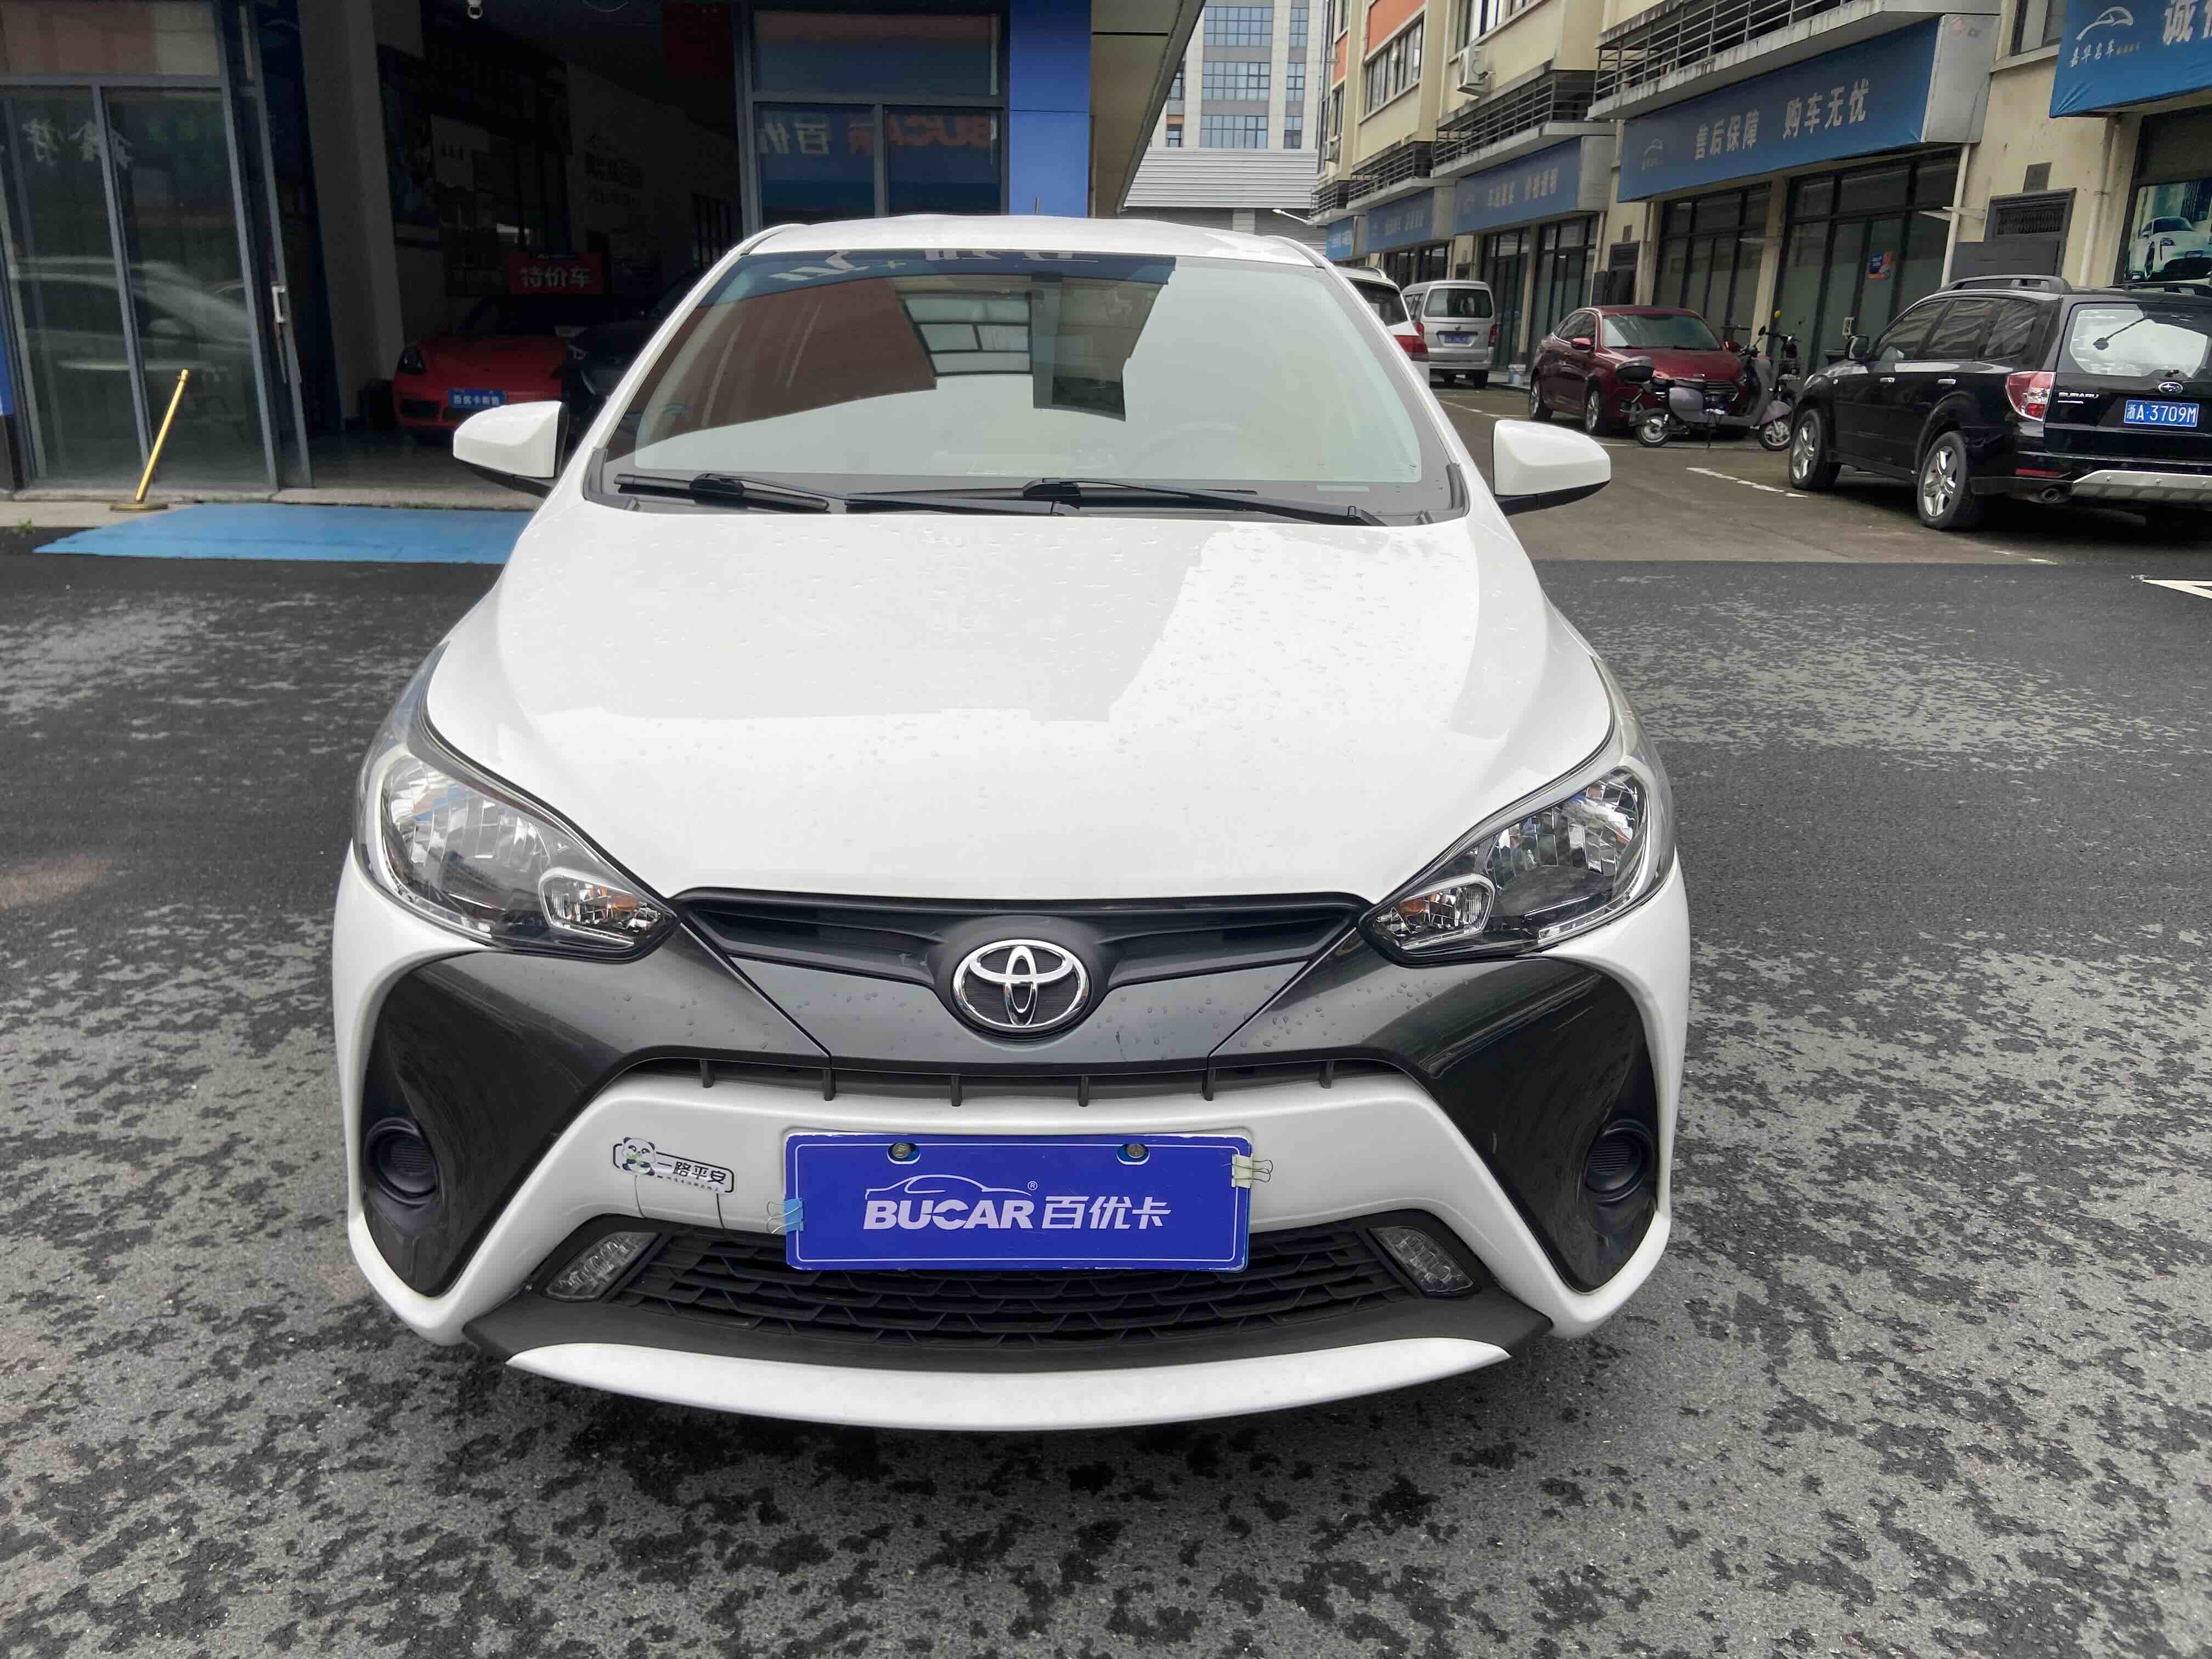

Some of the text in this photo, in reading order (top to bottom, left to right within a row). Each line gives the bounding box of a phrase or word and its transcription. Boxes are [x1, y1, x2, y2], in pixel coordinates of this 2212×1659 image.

[1694, 77, 1870, 160] 售后保障 购车无忧
[657, 1161, 727, 1185] 一路平安
[864, 1199, 1035, 1231] BUCAR
[1042, 1195, 1172, 1230] 百优卡
